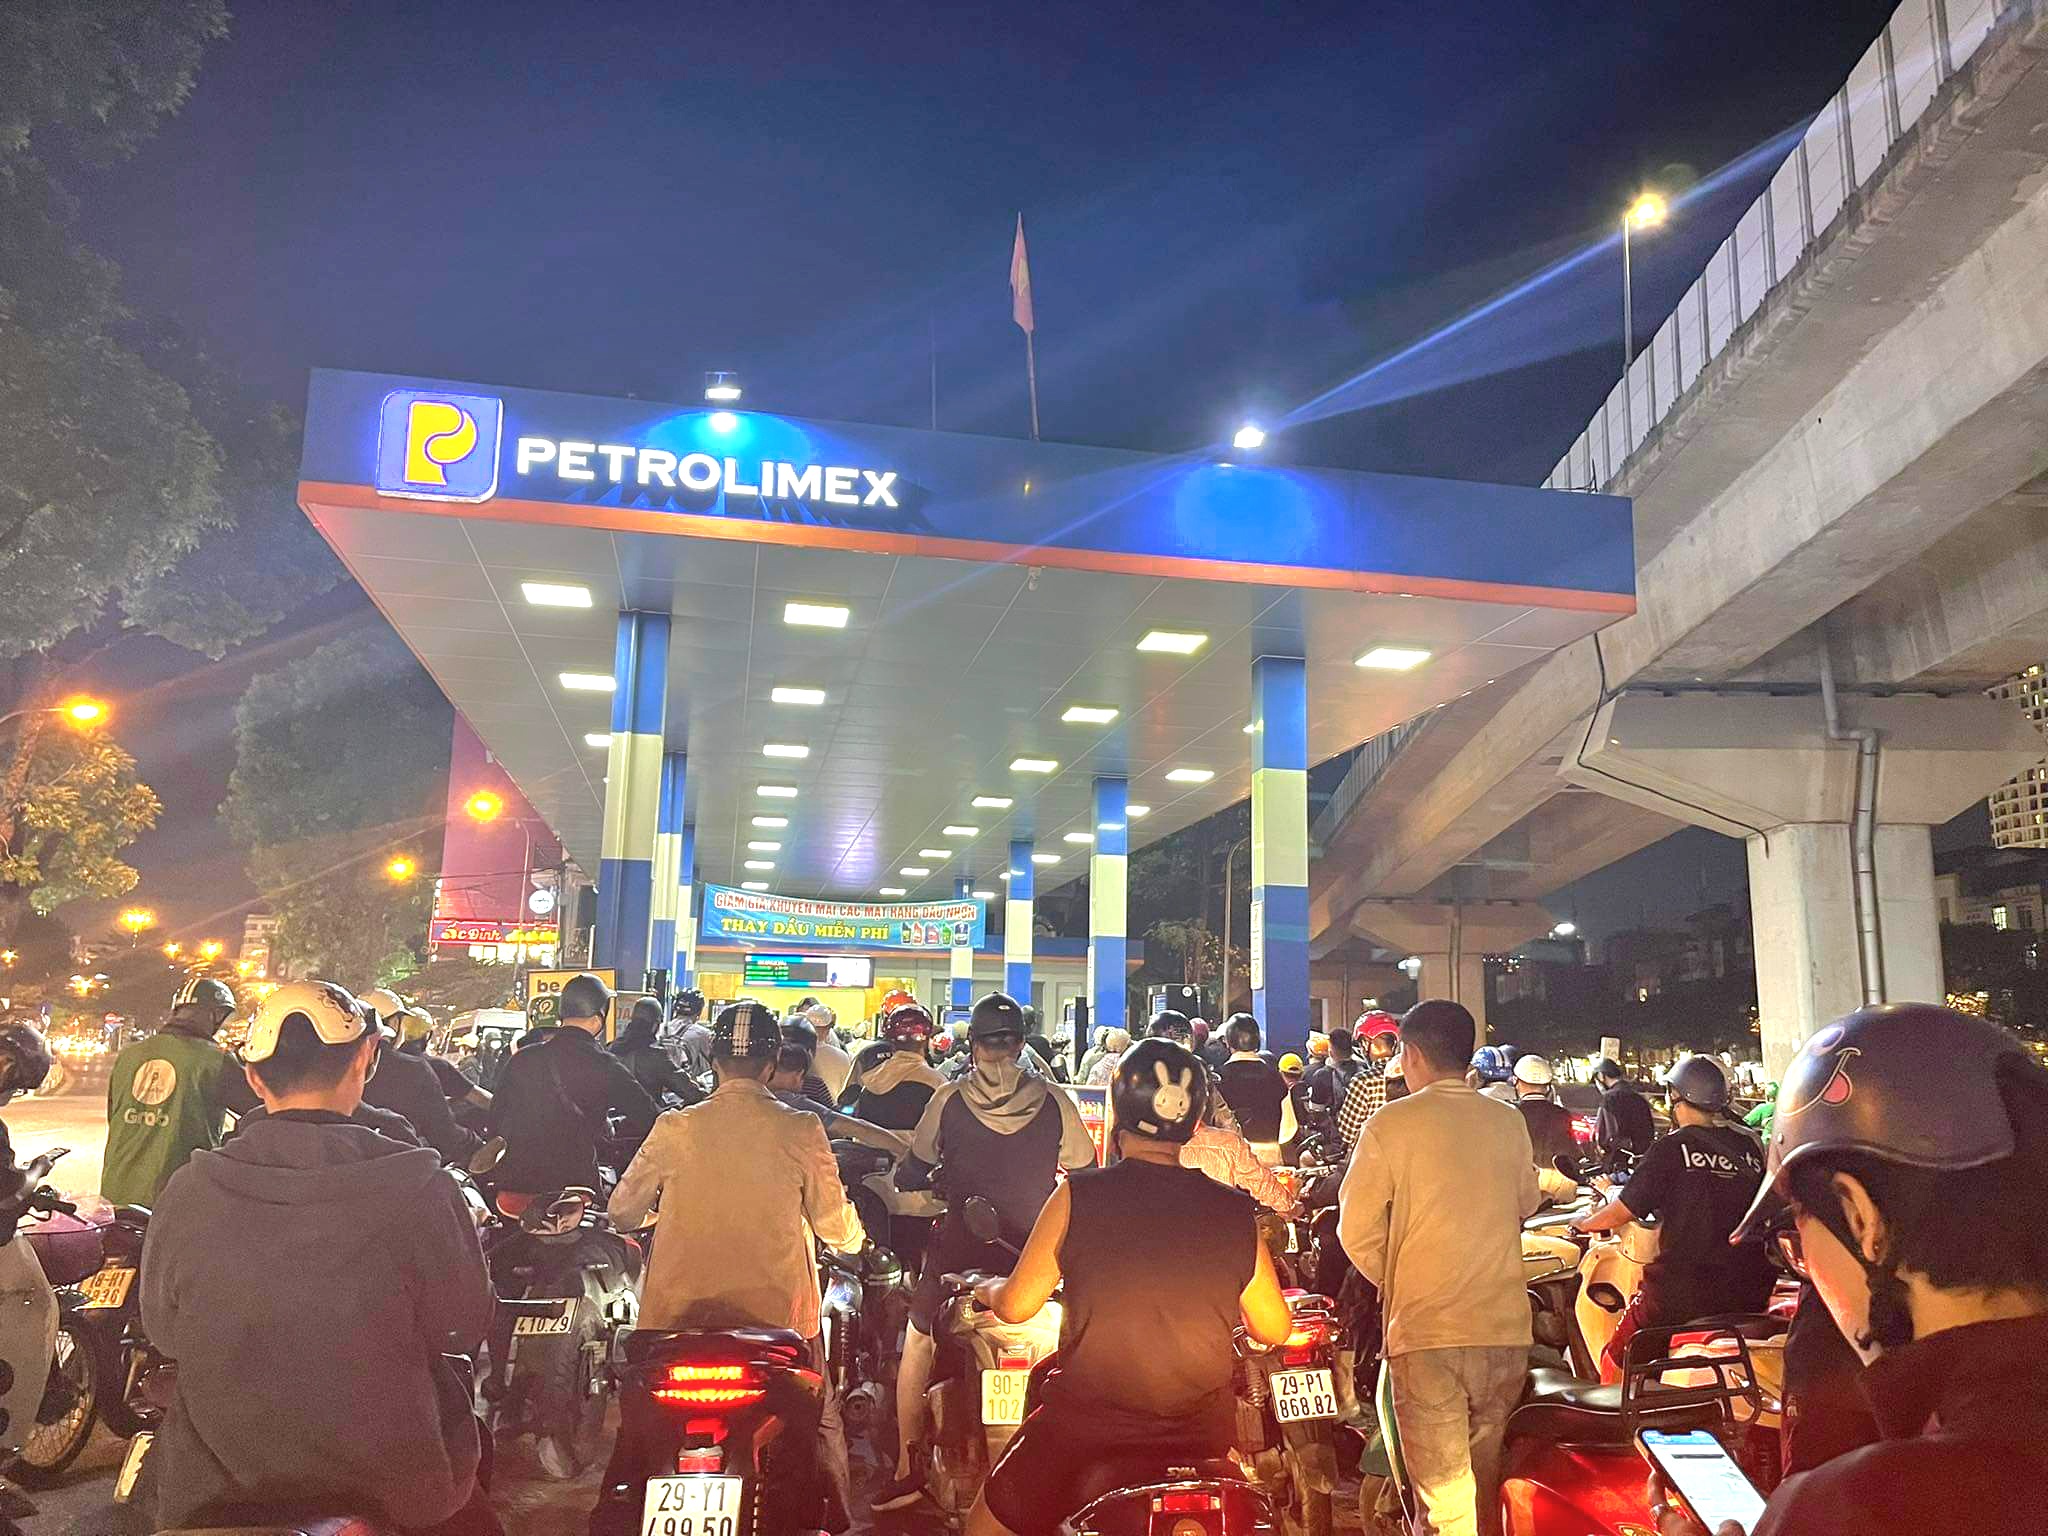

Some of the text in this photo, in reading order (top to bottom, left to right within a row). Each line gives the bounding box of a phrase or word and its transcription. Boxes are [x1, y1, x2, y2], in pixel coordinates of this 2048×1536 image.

[516, 436, 899, 507] PETROLIMEX
[721, 917, 769, 934] THAY
[860, 923, 889, 940] PHÍ
[537, 979, 560, 993] be
[124, 1107, 170, 1128] Grab
[1681, 1143, 1761, 1174] levets
[1280, 1373, 1324, 1396] 29-P1
[1279, 1394, 1335, 1418] 868.82
[658, 1482, 726, 1512] 29-Y1
